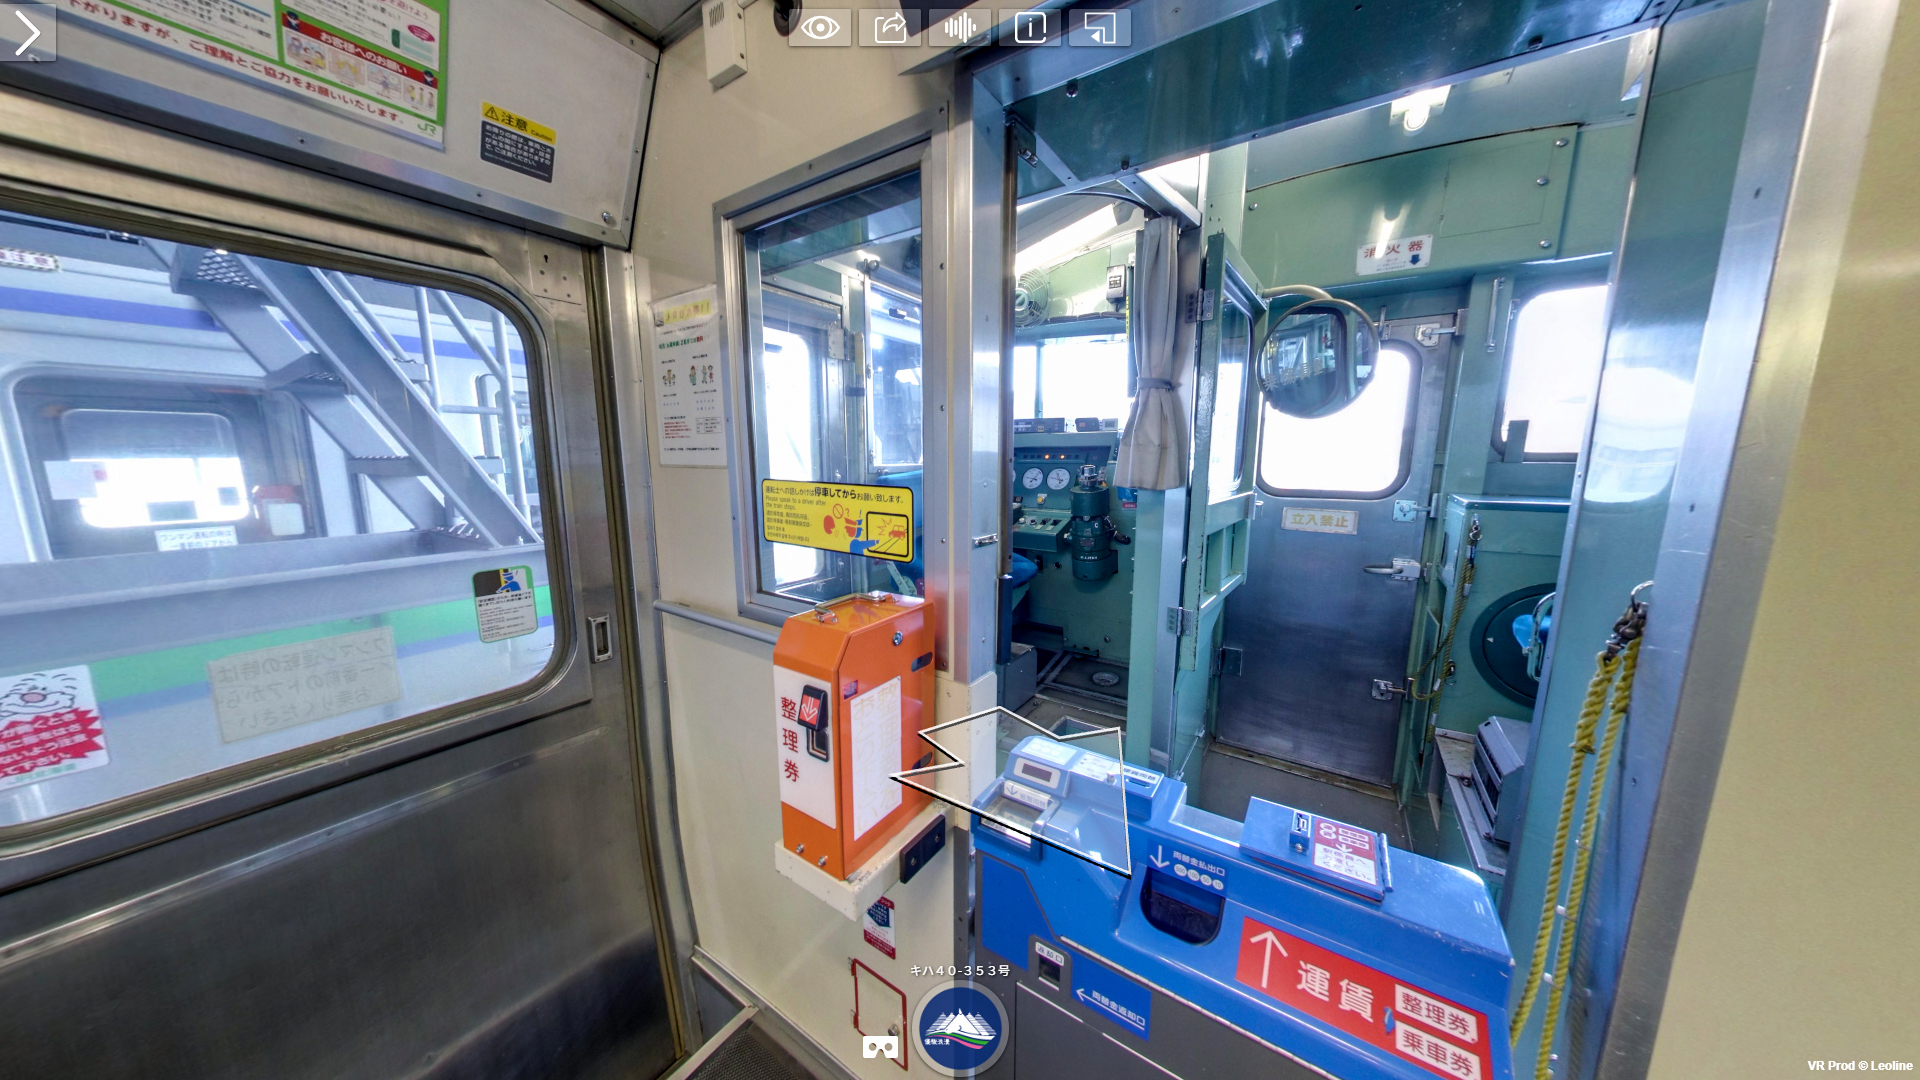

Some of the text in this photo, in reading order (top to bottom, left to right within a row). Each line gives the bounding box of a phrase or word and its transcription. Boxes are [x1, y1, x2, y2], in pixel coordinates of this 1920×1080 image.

[320, 32, 407, 74] お客様へのお願い
[417, 123, 437, 134] JR
[501, 111, 527, 132] 注意
[530, 129, 553, 142] Caution
[1364, 240, 1424, 258] 消火器
[765, 485, 904, 504] 運転士への話しかけは停車してからお願い致します。
[1291, 513, 1349, 528] 立入禁止
[781, 697, 799, 783] 整理券
[1173, 850, 1225, 877] 両替金払出口
[1175, 866, 1185, 875] 500
[1189, 871, 1198, 880] 100
[1038, 945, 1062, 964] 返却口
[1296, 960, 1374, 1023] 運賃
[1092, 990, 1145, 1027] 両替金返却口
[1402, 991, 1470, 1036] 整理券
[1403, 1029, 1473, 1077] 乗車券
